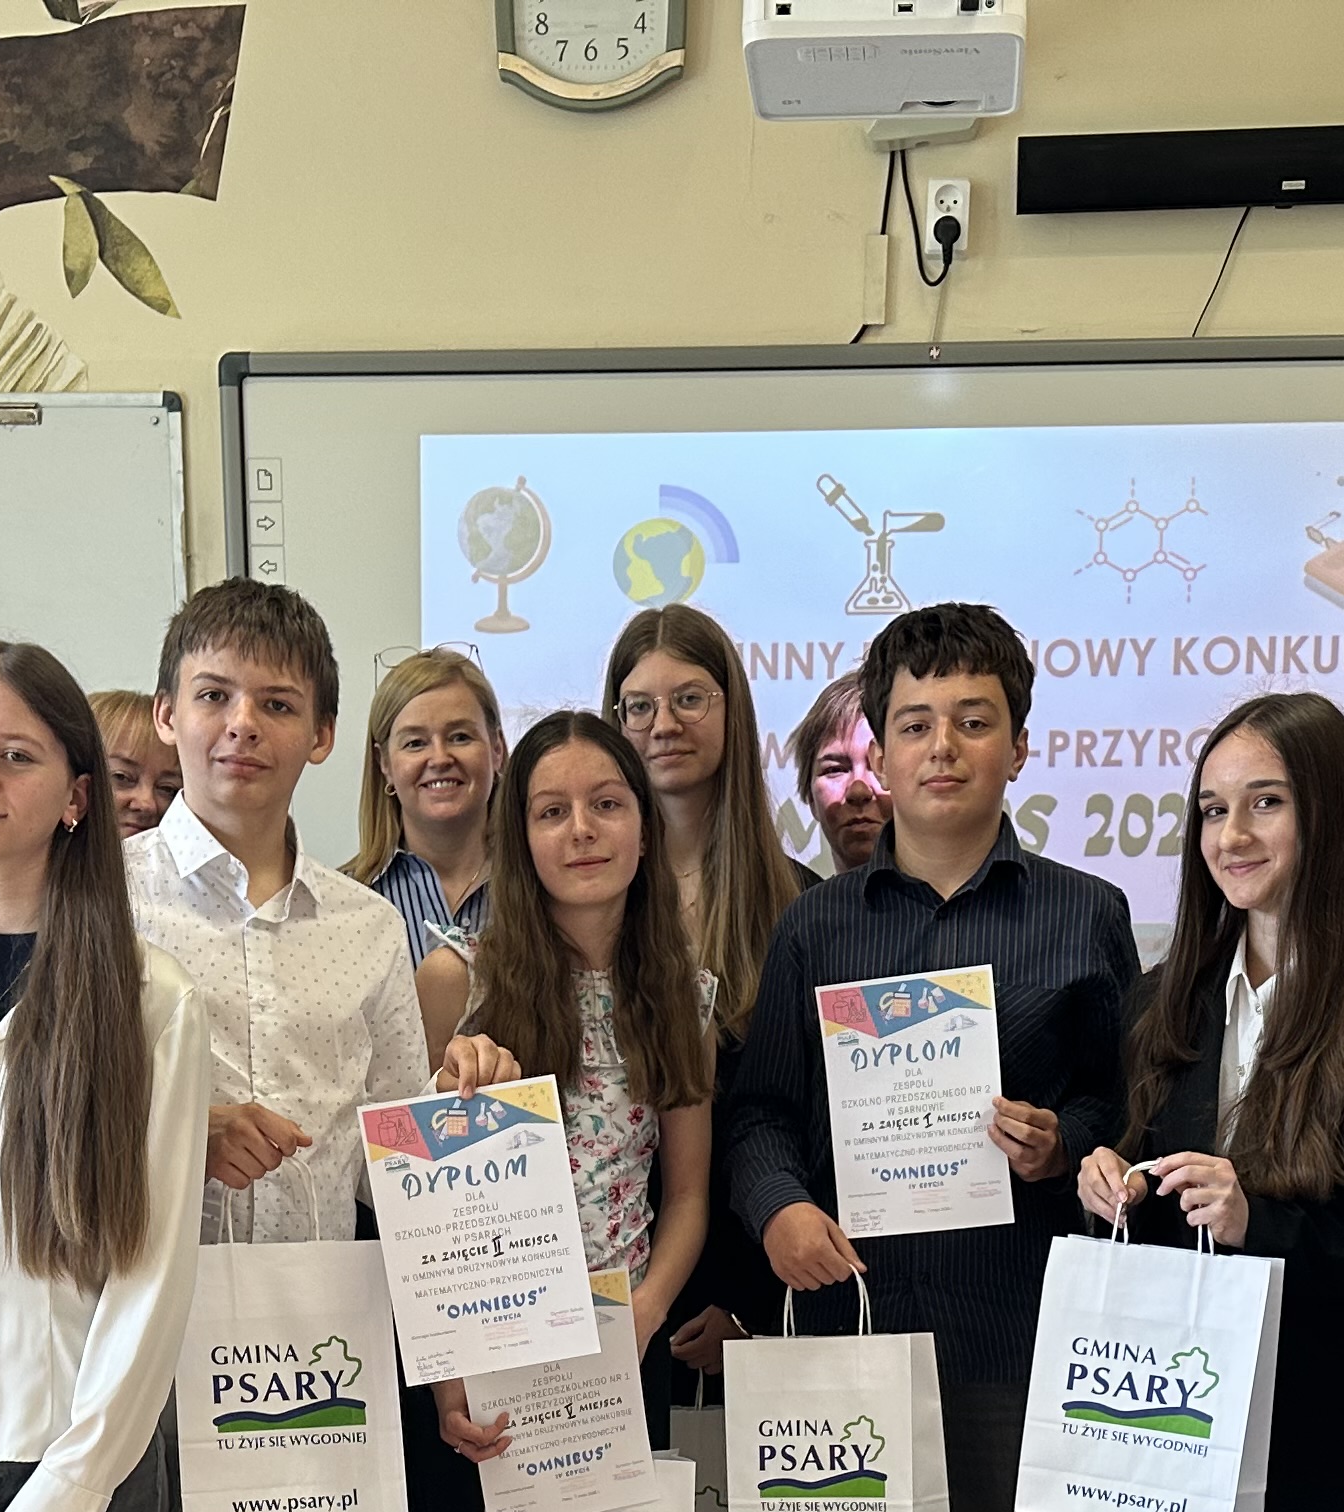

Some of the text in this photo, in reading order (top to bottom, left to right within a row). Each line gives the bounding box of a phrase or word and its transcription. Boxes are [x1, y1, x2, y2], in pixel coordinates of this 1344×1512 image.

[535, 12, 549, 36] 8
[634, 11, 647, 34] 4
[556, 40, 568, 62] 7
[584, 38, 598, 61] 6
[616, 38, 629, 60] 5
[1084, 792, 1184, 858] 202
[850, 1036, 961, 1072] DYPLOM
[905, 1068, 922, 1077] DLA
[984, 1085, 990, 1093] 2
[862, 1122, 874, 1131] ZA
[937, 1111, 981, 1124] MIEJSCA
[402, 1154, 527, 1200] DYPLOM
[465, 1191, 485, 1202] DLA
[453, 1202, 499, 1217] ZESPOŁU
[541, 1205, 556, 1217] NR
[557, 1204, 564, 1214] 3
[452, 1226, 511, 1245] W PSARACH
[422, 1233, 558, 1265] ZA ZAJĘCIE II MIEJSCA
[211, 1344, 299, 1365] GMINA
[1072, 1337, 1157, 1366] GMINA
[212, 1370, 344, 1404] PSARY
[1066, 1362, 1199, 1407] PSARY
[564, 1403, 576, 1420] V
[579, 1397, 623, 1412] MIEJSCA
[758, 1419, 833, 1437] GMINA
[216, 1431, 367, 1450] TU ŻYJE SIĘ WYGODNIEJ
[1062, 1423, 1208, 1457] TU ŻYJE SIĘ WYGODNIEJ
[759, 1444, 871, 1471] PSARY
[760, 1499, 887, 1512] TU ŻYJE SIĘ WYGODNIEJ
